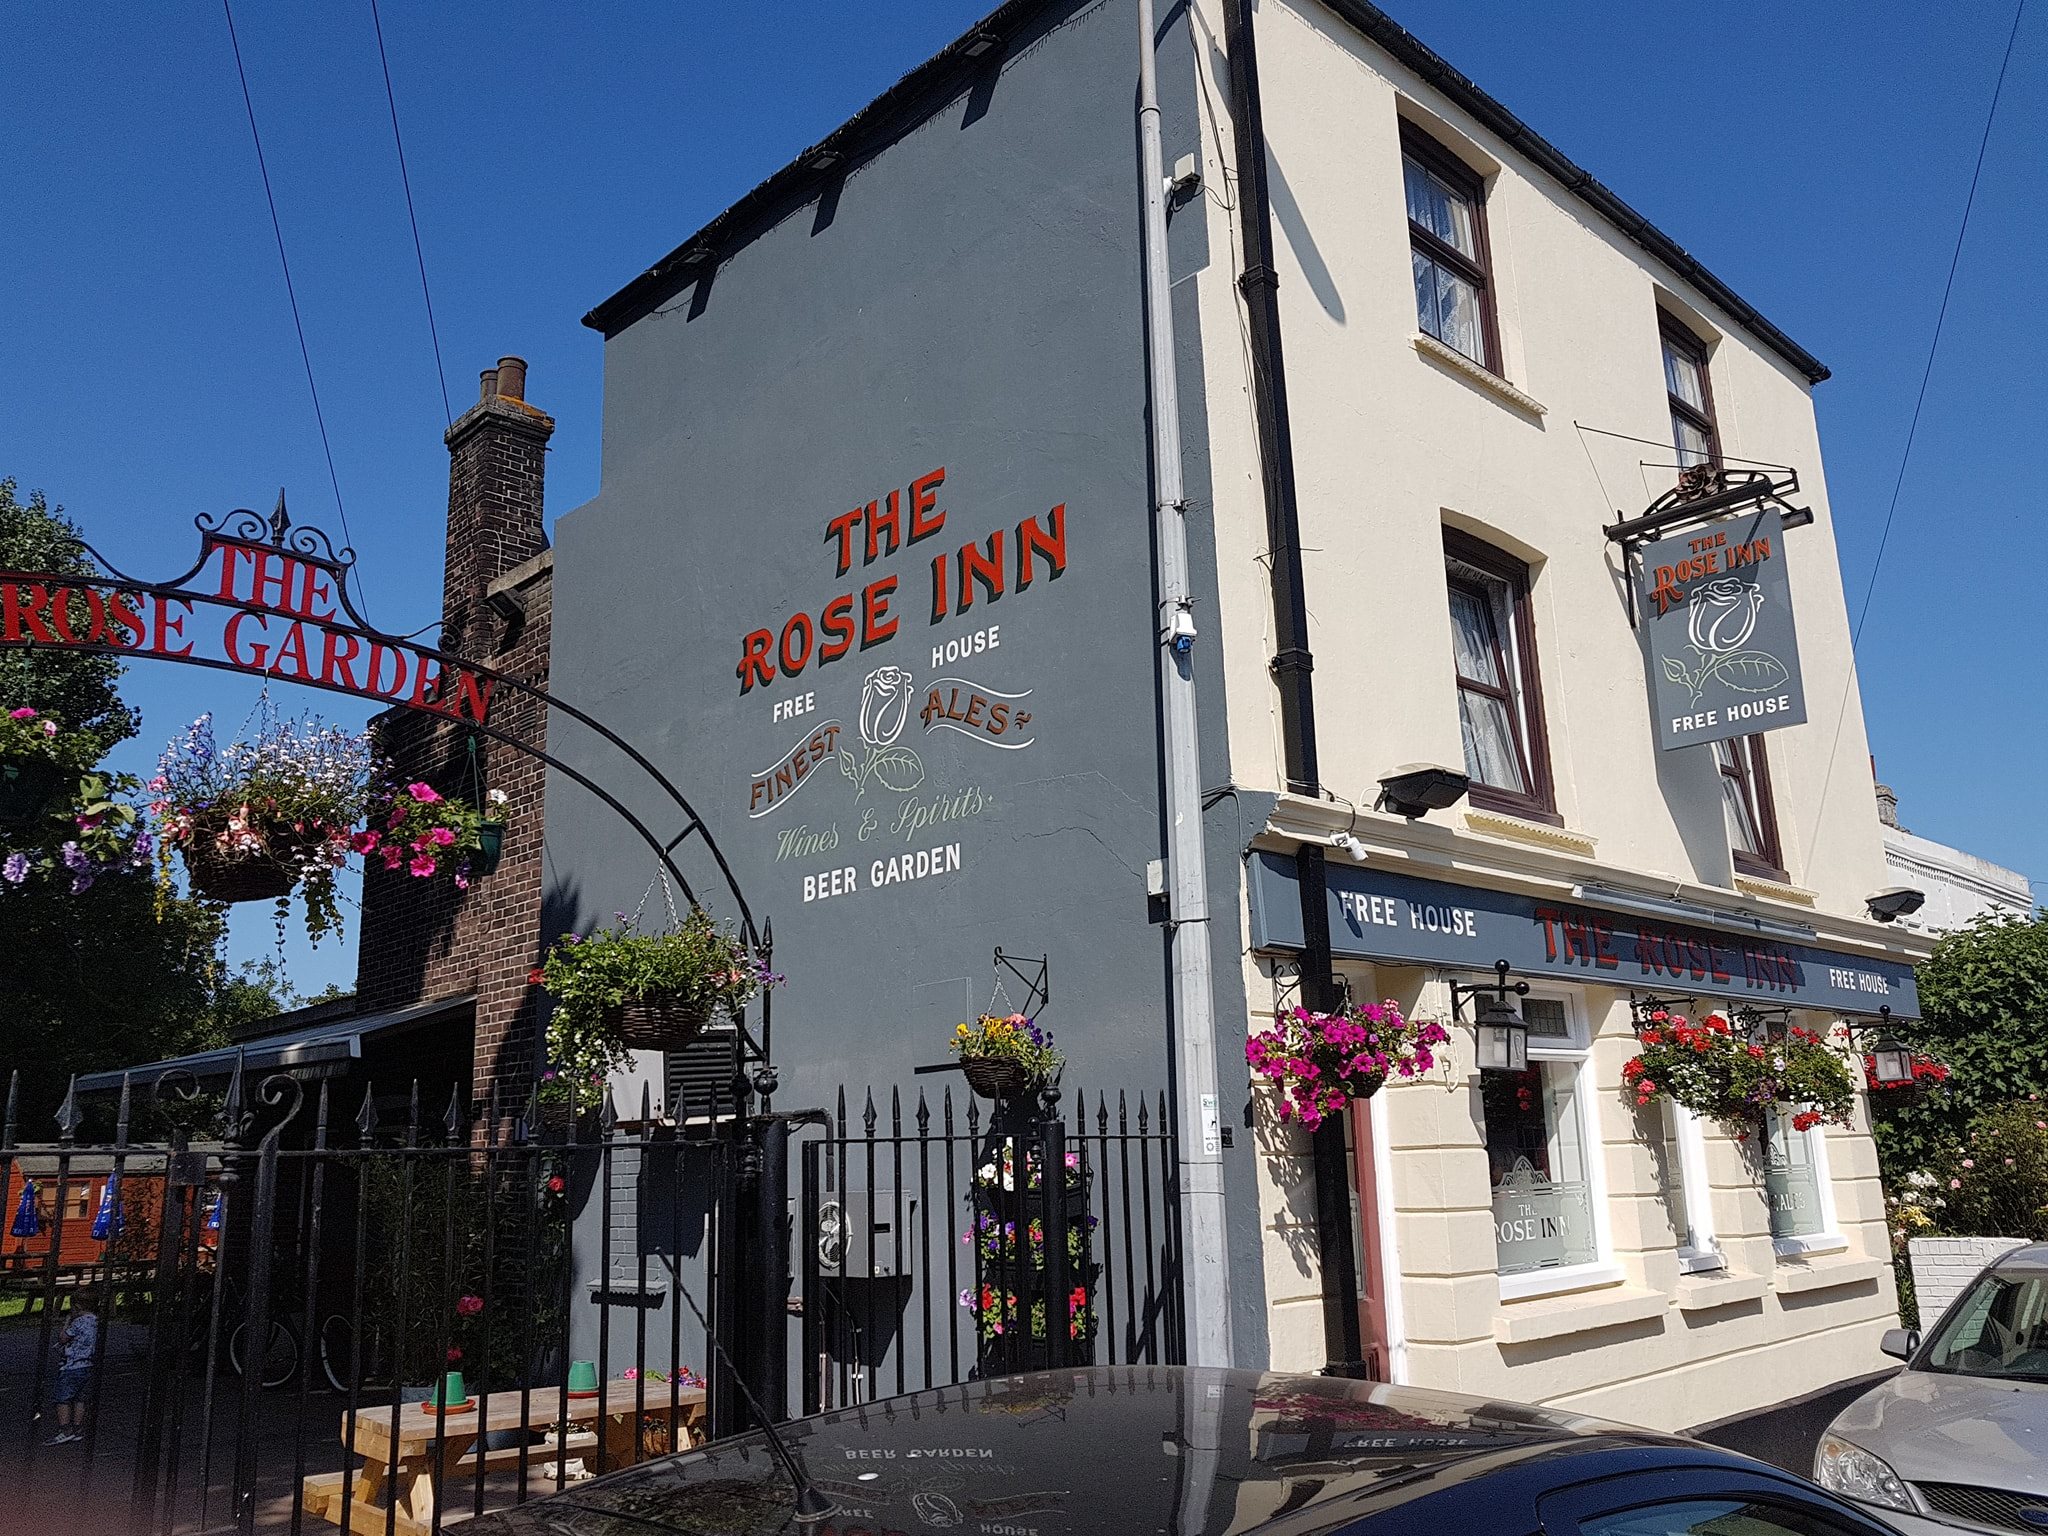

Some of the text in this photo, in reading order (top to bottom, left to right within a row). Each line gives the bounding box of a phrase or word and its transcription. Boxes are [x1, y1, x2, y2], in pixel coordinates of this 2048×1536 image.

[824, 466, 946, 578] THE
[1688, 531, 1727, 554] THE
[210, 540, 337, 623] THE
[736, 502, 1066, 696] ROSE INN
[1650, 536, 1771, 620] ROSE INN
[1, 582, 498, 725] ROSE GARDEN
[773, 625, 1000, 723] FREE HOUSE
[750, 687, 1009, 810] FINEST ALES
[1672, 695, 1790, 733] FREE HOUSE
[775, 786, 984, 863] Wines & Spirits
[803, 843, 961, 902] BEER GARDEN
[1340, 890, 1477, 937] FREE HOUSE
[1534, 906, 1799, 994] THE ROSE INN
[1829, 968, 1890, 995] FREE HOUSE
[1541, 1216, 1571, 1238] INN
